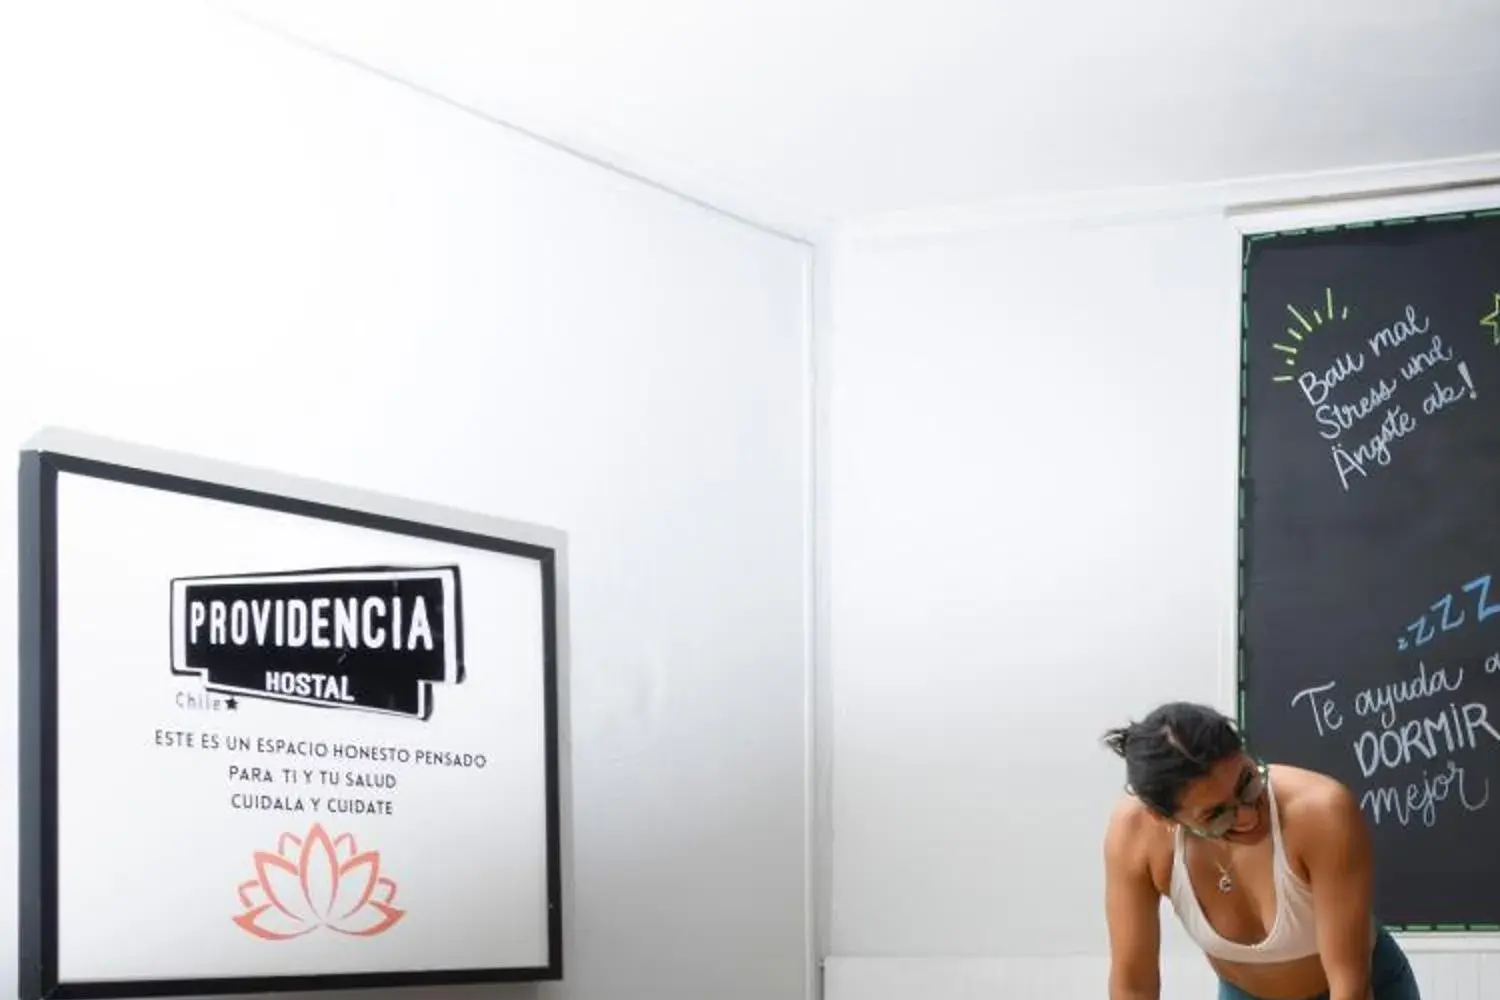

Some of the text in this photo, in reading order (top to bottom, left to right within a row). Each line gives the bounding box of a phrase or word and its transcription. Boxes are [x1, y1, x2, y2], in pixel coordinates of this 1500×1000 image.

[1298, 304, 1430, 406] Bau mal
[1315, 335, 1453, 440] Stress und
[1331, 361, 1477, 491] Ängste ab!
[189, 594, 434, 651] PROVIDENCIA
[175, 690, 221, 711] Chile
[264, 670, 355, 702] HOSTAL
[1291, 680, 1343, 737] Te
[1354, 660, 1464, 729] ayuda
[154, 729, 487, 769] ESTE ES UN ESPACIO HONESTO PENSADO
[229, 765, 397, 790] PARA TI Y TU SALUD
[231, 793, 393, 815] CUIDALA Y CUIDATE
[1359, 760, 1489, 828] mejor
